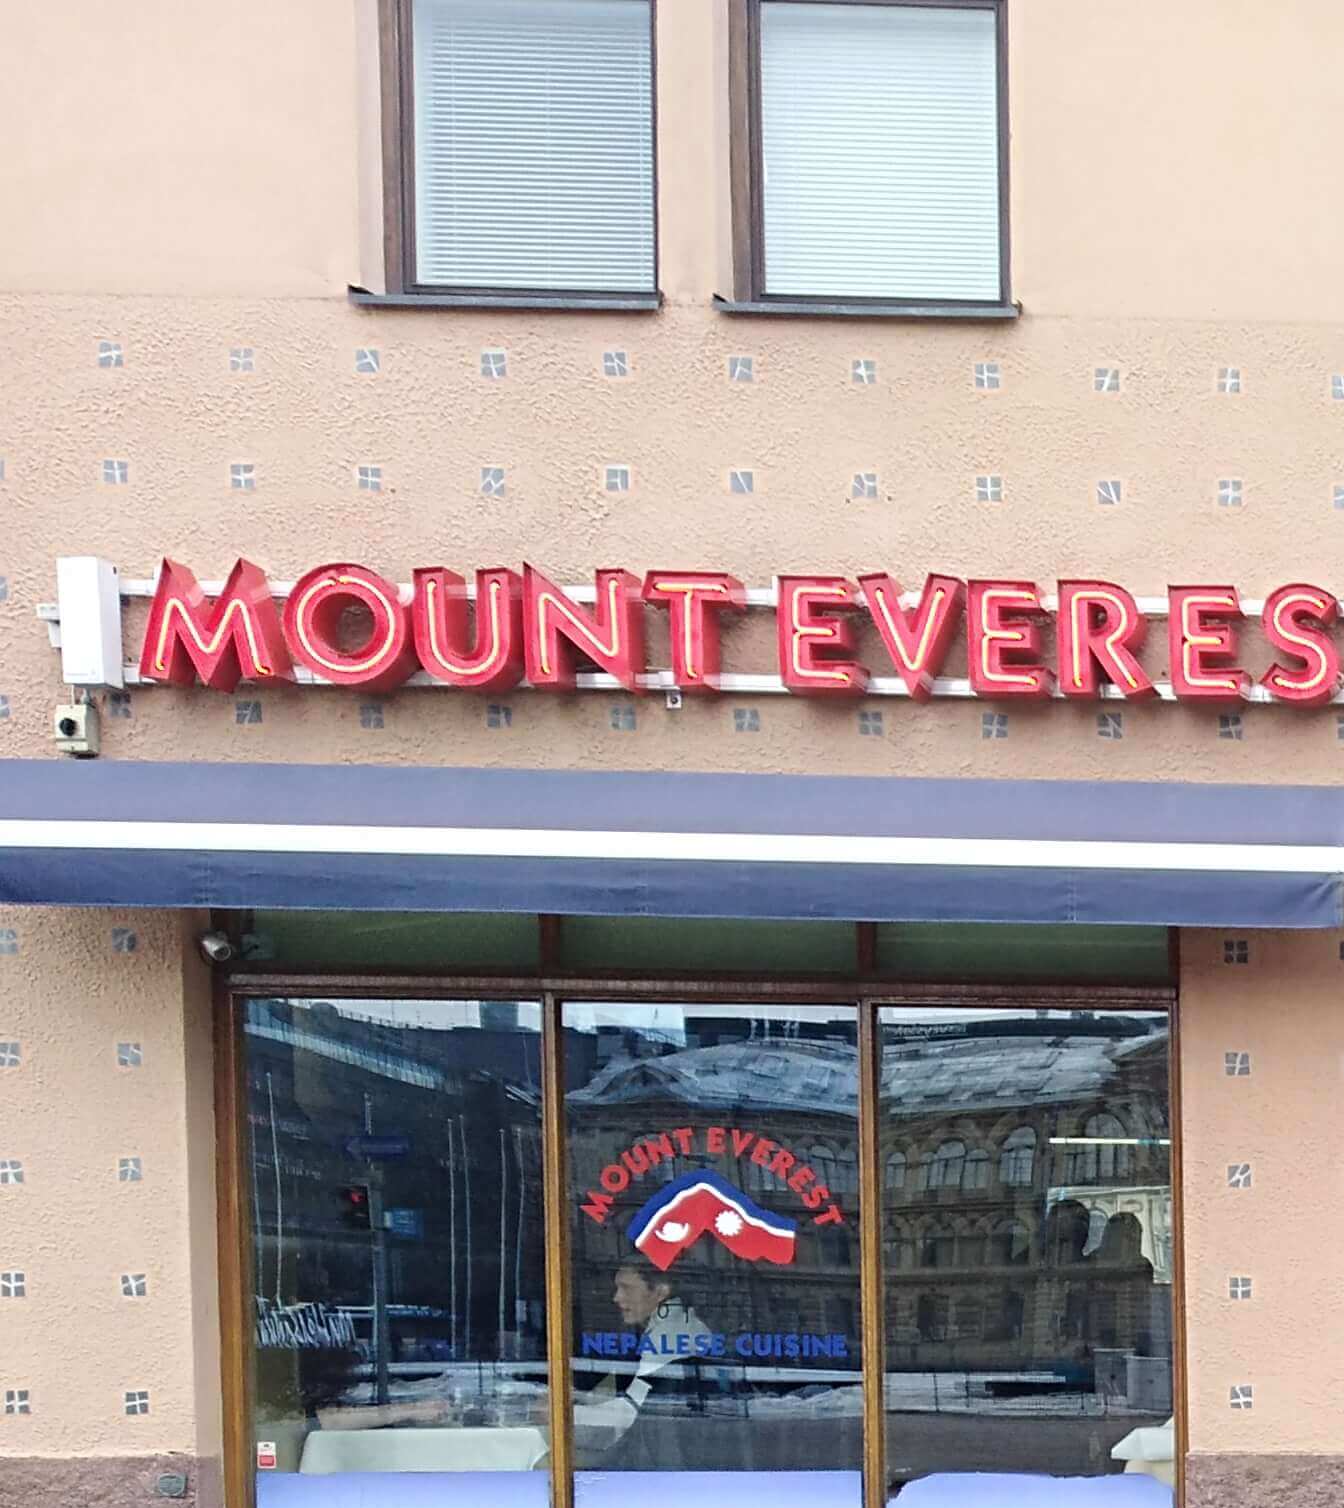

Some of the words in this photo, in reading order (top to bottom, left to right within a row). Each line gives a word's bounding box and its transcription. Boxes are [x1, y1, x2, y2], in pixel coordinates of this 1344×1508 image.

[139, 557, 745, 693] MOUNT
[579, 1127, 694, 1225] MOUNT
[706, 1126, 845, 1226] EVEREST
[581, 1331, 726, 1356] NEPALESE
[735, 1333, 848, 1358] CUISINE
